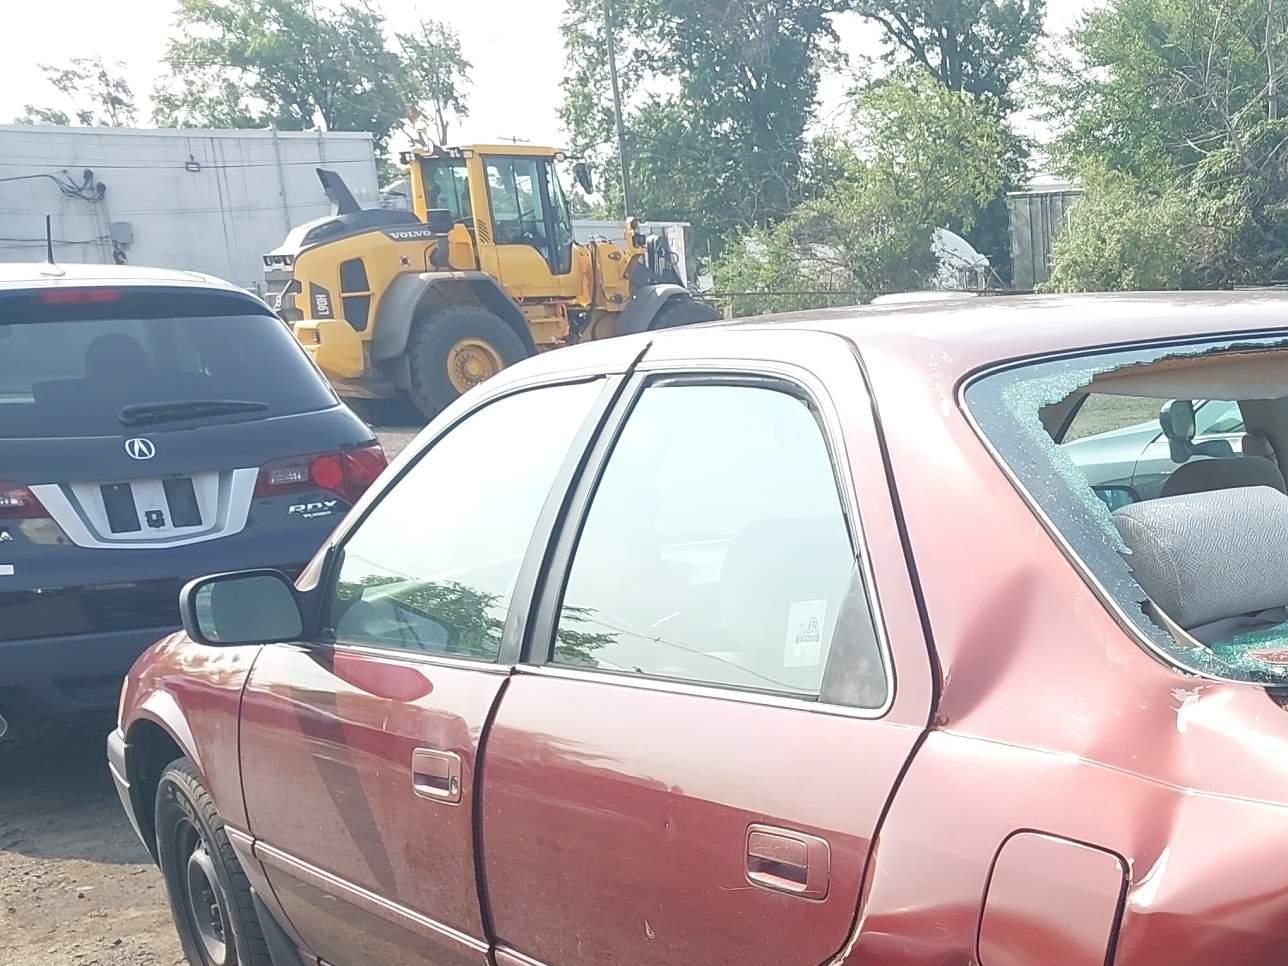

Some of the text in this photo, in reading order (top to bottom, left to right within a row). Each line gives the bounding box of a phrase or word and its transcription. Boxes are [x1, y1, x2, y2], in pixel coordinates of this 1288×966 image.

[389, 230, 432, 239] VOLVO
[315, 294, 330, 315] L90H
[288, 500, 337, 515] RDX
